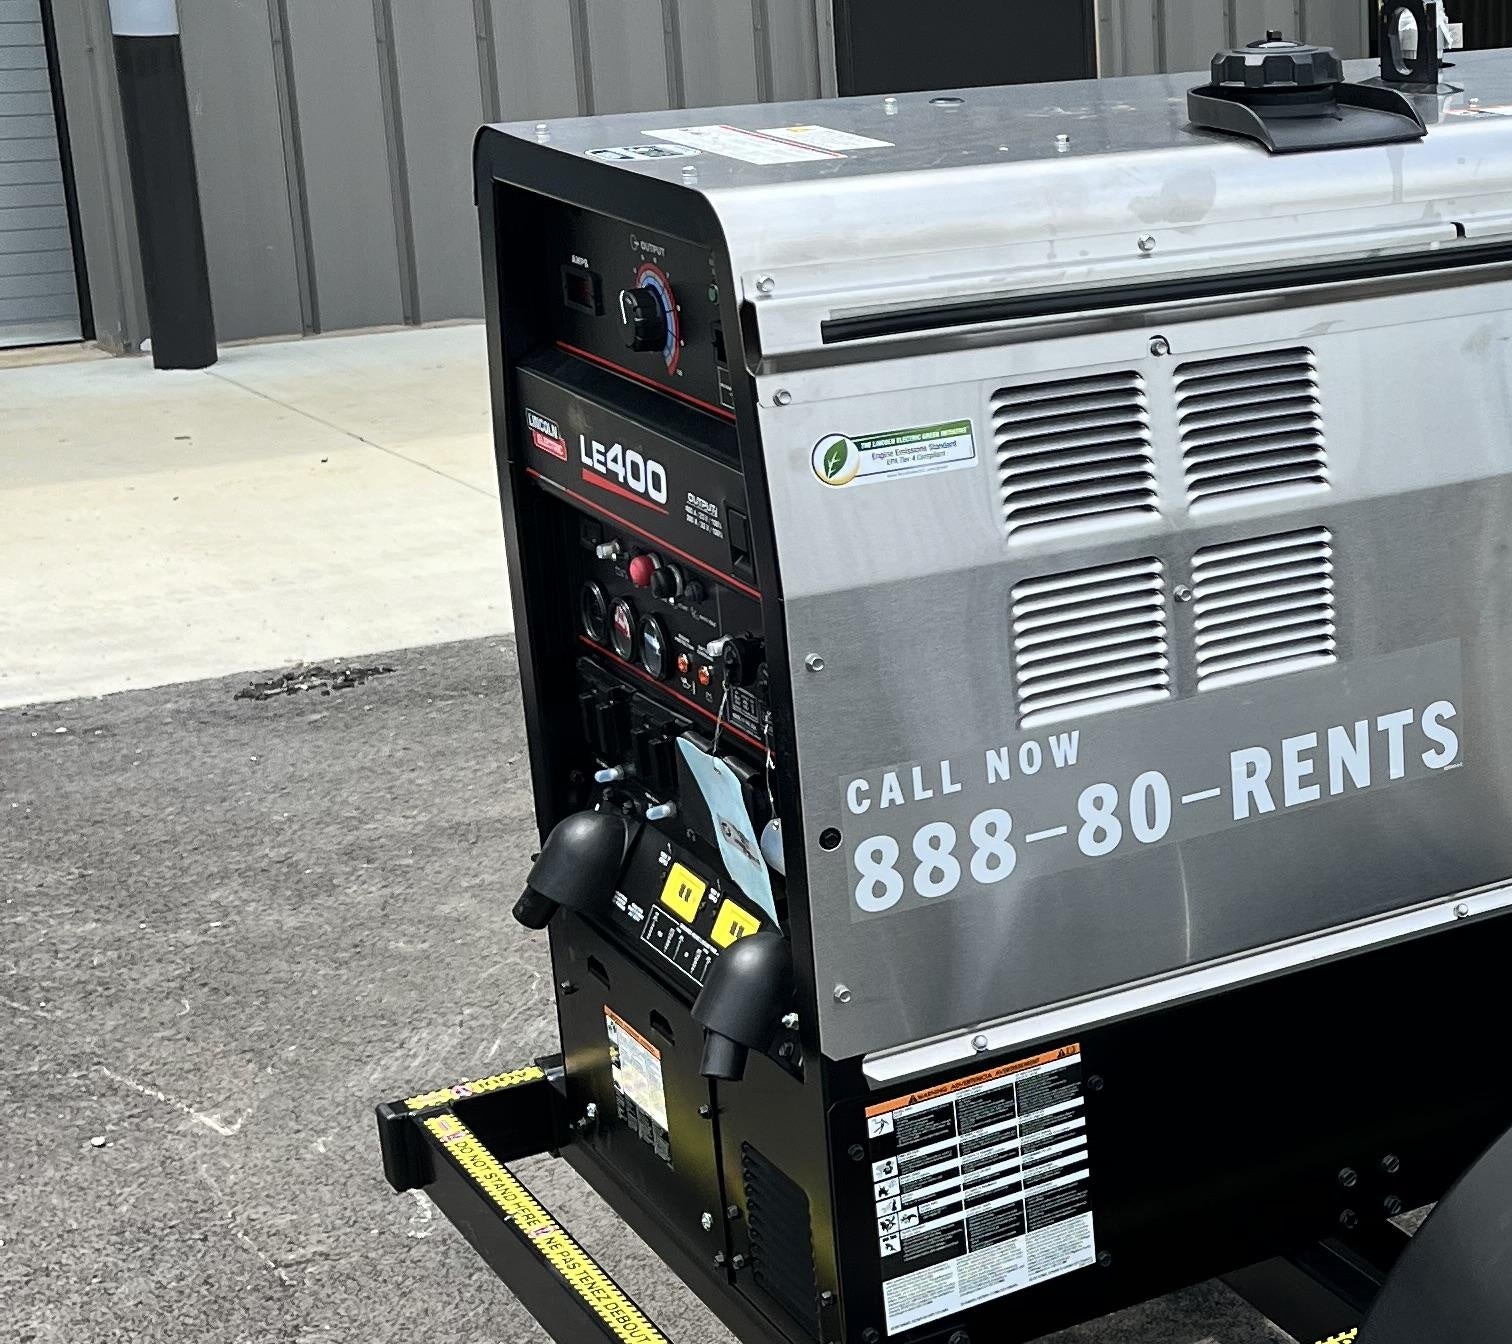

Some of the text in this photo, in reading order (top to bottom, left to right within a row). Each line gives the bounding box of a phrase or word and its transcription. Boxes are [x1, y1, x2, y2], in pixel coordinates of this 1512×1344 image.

[579, 434, 668, 505] LE400
[845, 730, 1081, 816] CALL NOW
[853, 699, 1460, 913] 888-80-RENTS
[455, 1141, 541, 1227] DO NOT STAND HERE
[544, 1236, 564, 1251] NE
[556, 1250, 582, 1270] PAS
[577, 1269, 613, 1303] TENEZ
[603, 1301, 652, 1343] DEBOUT
